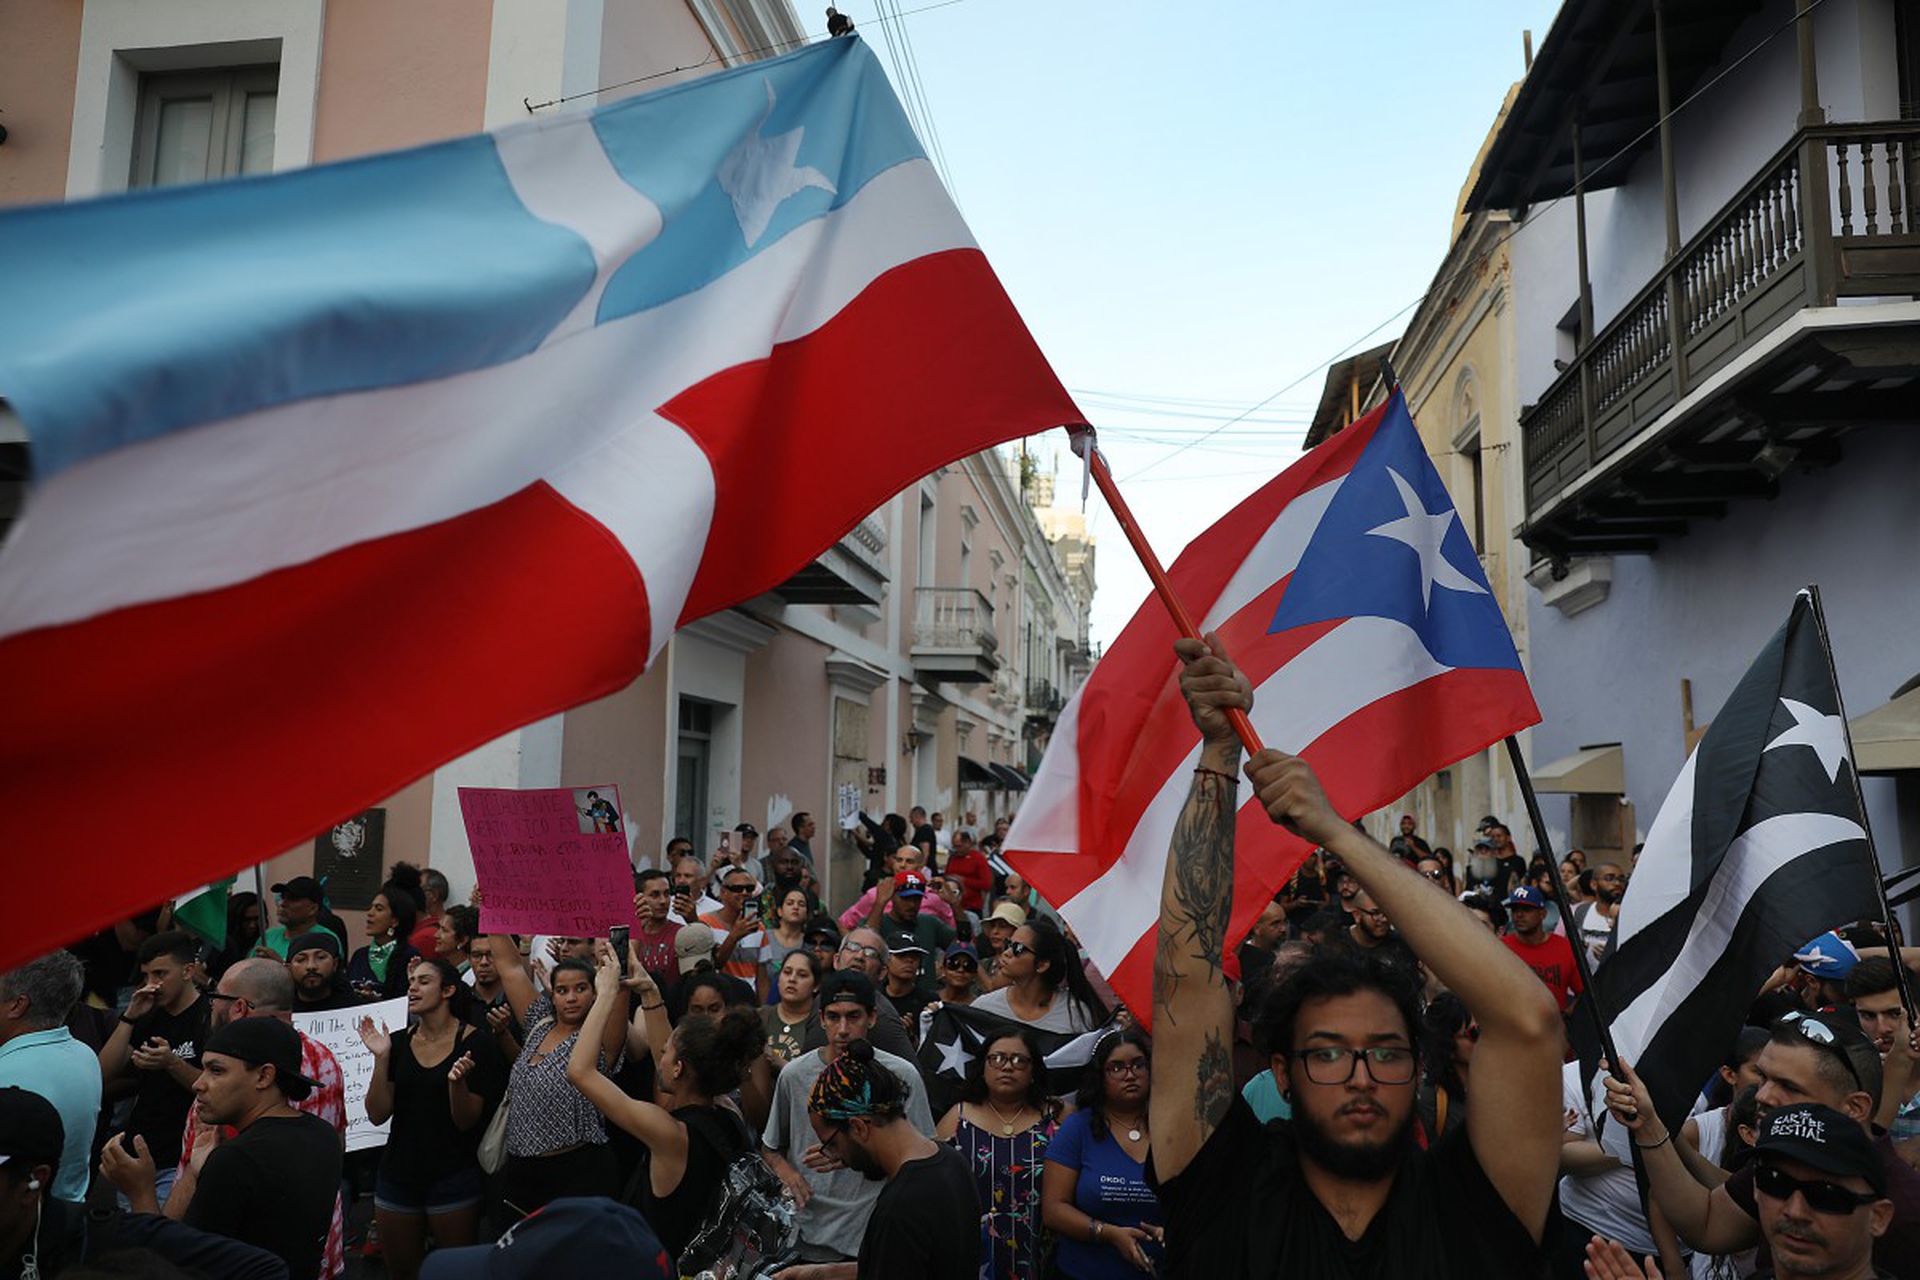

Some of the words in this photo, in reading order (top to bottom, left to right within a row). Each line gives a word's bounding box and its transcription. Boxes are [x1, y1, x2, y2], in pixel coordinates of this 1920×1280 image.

[308, 1019, 325, 1035] All
[329, 1018, 346, 1033] The
[1770, 1124, 1826, 1143] BESTIAL
